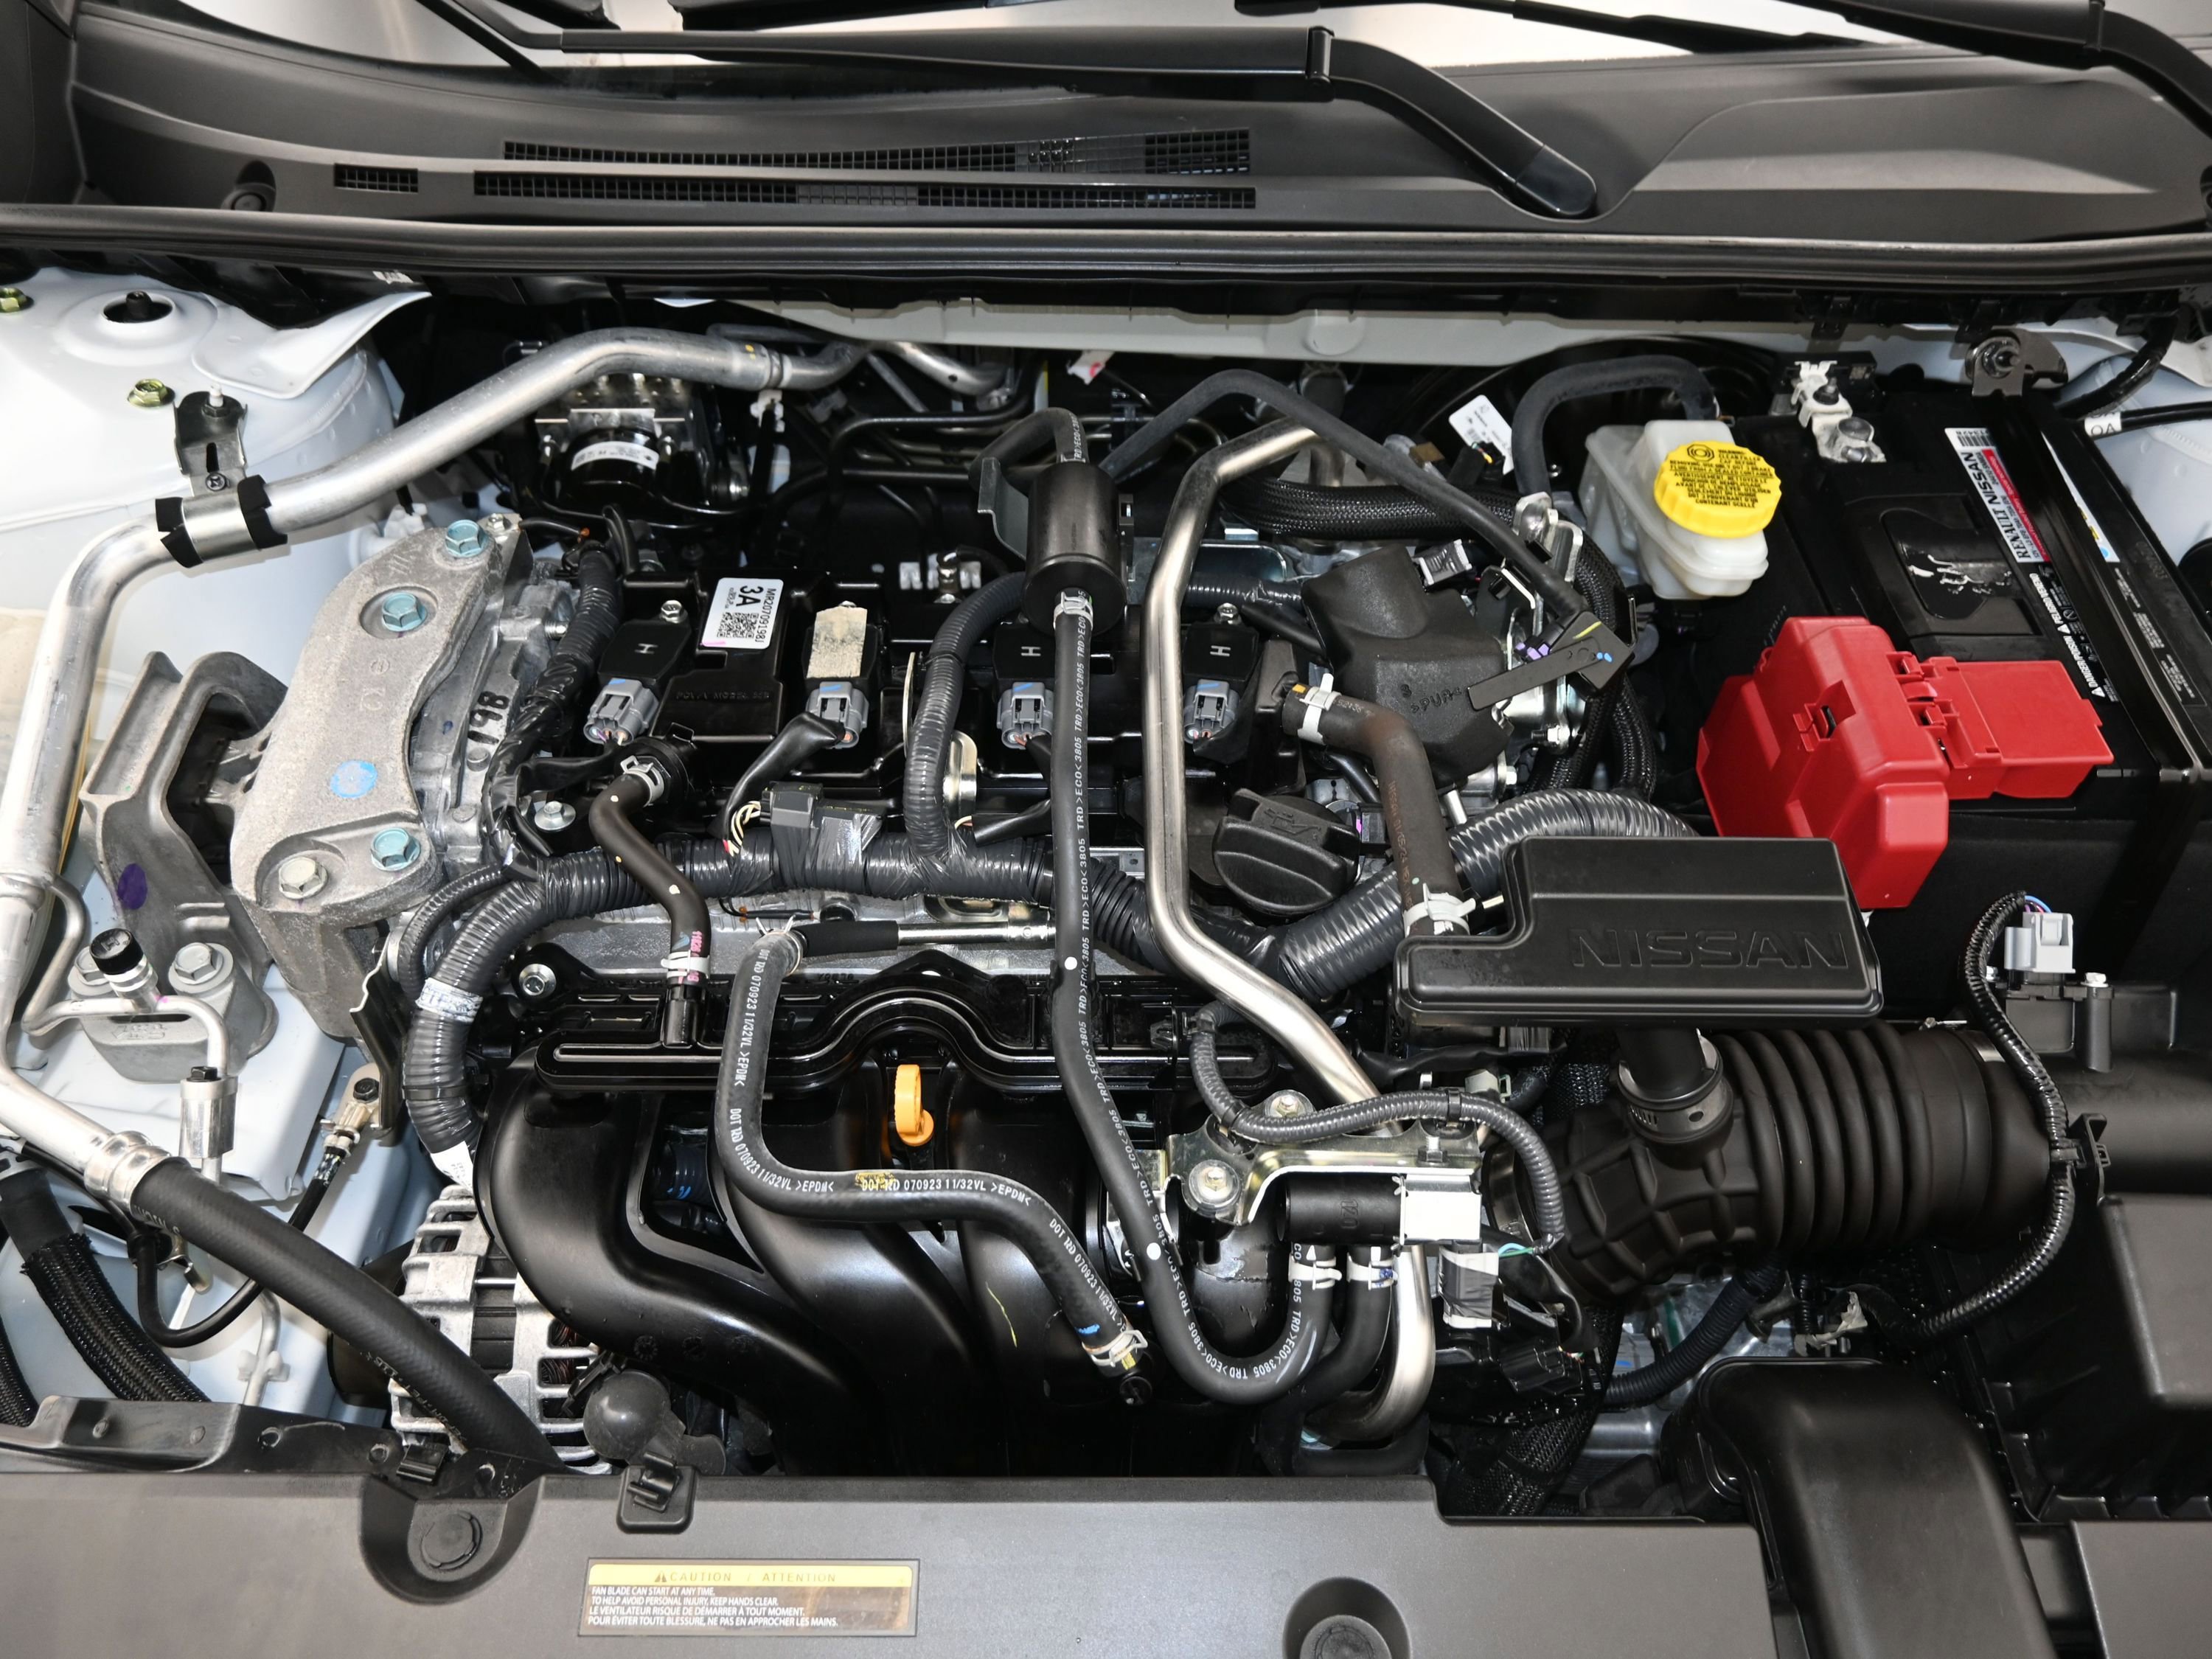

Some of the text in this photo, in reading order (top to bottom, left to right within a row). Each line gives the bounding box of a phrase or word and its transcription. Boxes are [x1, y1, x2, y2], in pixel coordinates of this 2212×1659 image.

[1959, 451, 2001, 504] NISSAN
[1991, 508, 2031, 558] RENAULT
[735, 585, 764, 606] 3A
[1569, 928, 1848, 970] NISSAN
[904, 1178, 942, 1191] 070923
[669, 1571, 731, 1582] CAUTION
[762, 1572, 836, 1582] ATTENTION
[591, 1586, 715, 1596] FAN BLADE CAN START AT ANY TIME.
[591, 1596, 602, 1605] TO
[602, 1596, 621, 1605] HELP
[622, 1596, 644, 1605] AVOID
[645, 1596, 682, 1605] PERSONAL
[710, 1597, 727, 1605] KEEP
[728, 1597, 754, 1605] HANDS
[754, 1597, 779, 1605] CLEAR.
[589, 1606, 805, 1617] LE VENTILATEUR RISQUE DE DÉMARRER À TOUT MOMENT.
[588, 1615, 838, 1627] POUR ÉVITER TOUTE BLESSURE, NE PAS EN APPROCHER LES MAINS.
